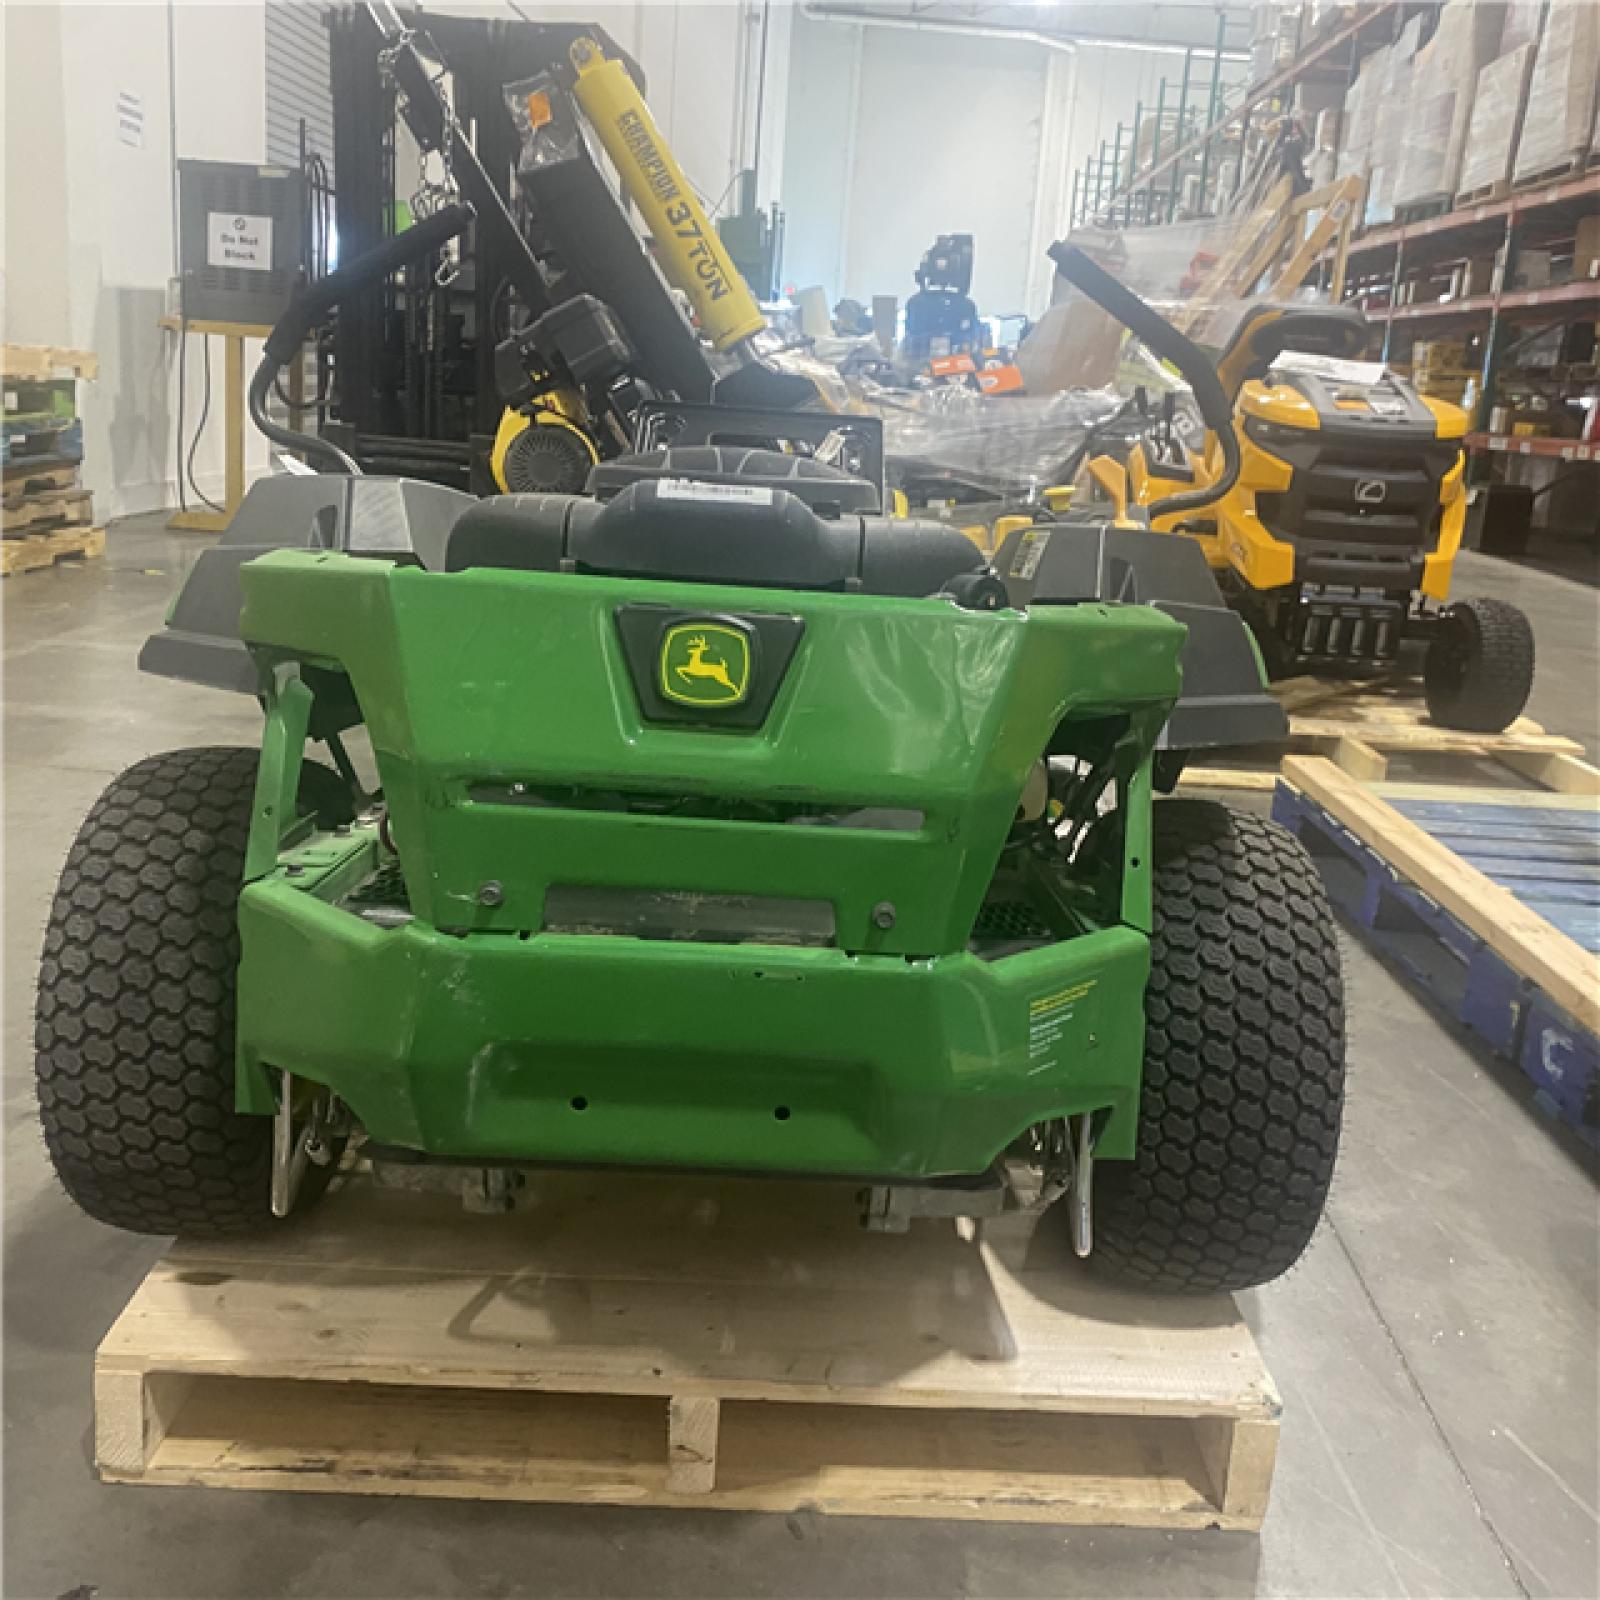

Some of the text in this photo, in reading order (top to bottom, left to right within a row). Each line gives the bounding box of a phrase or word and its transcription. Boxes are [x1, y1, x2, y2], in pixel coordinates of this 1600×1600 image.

[618, 109, 732, 300] CHAMPION 37 TON
